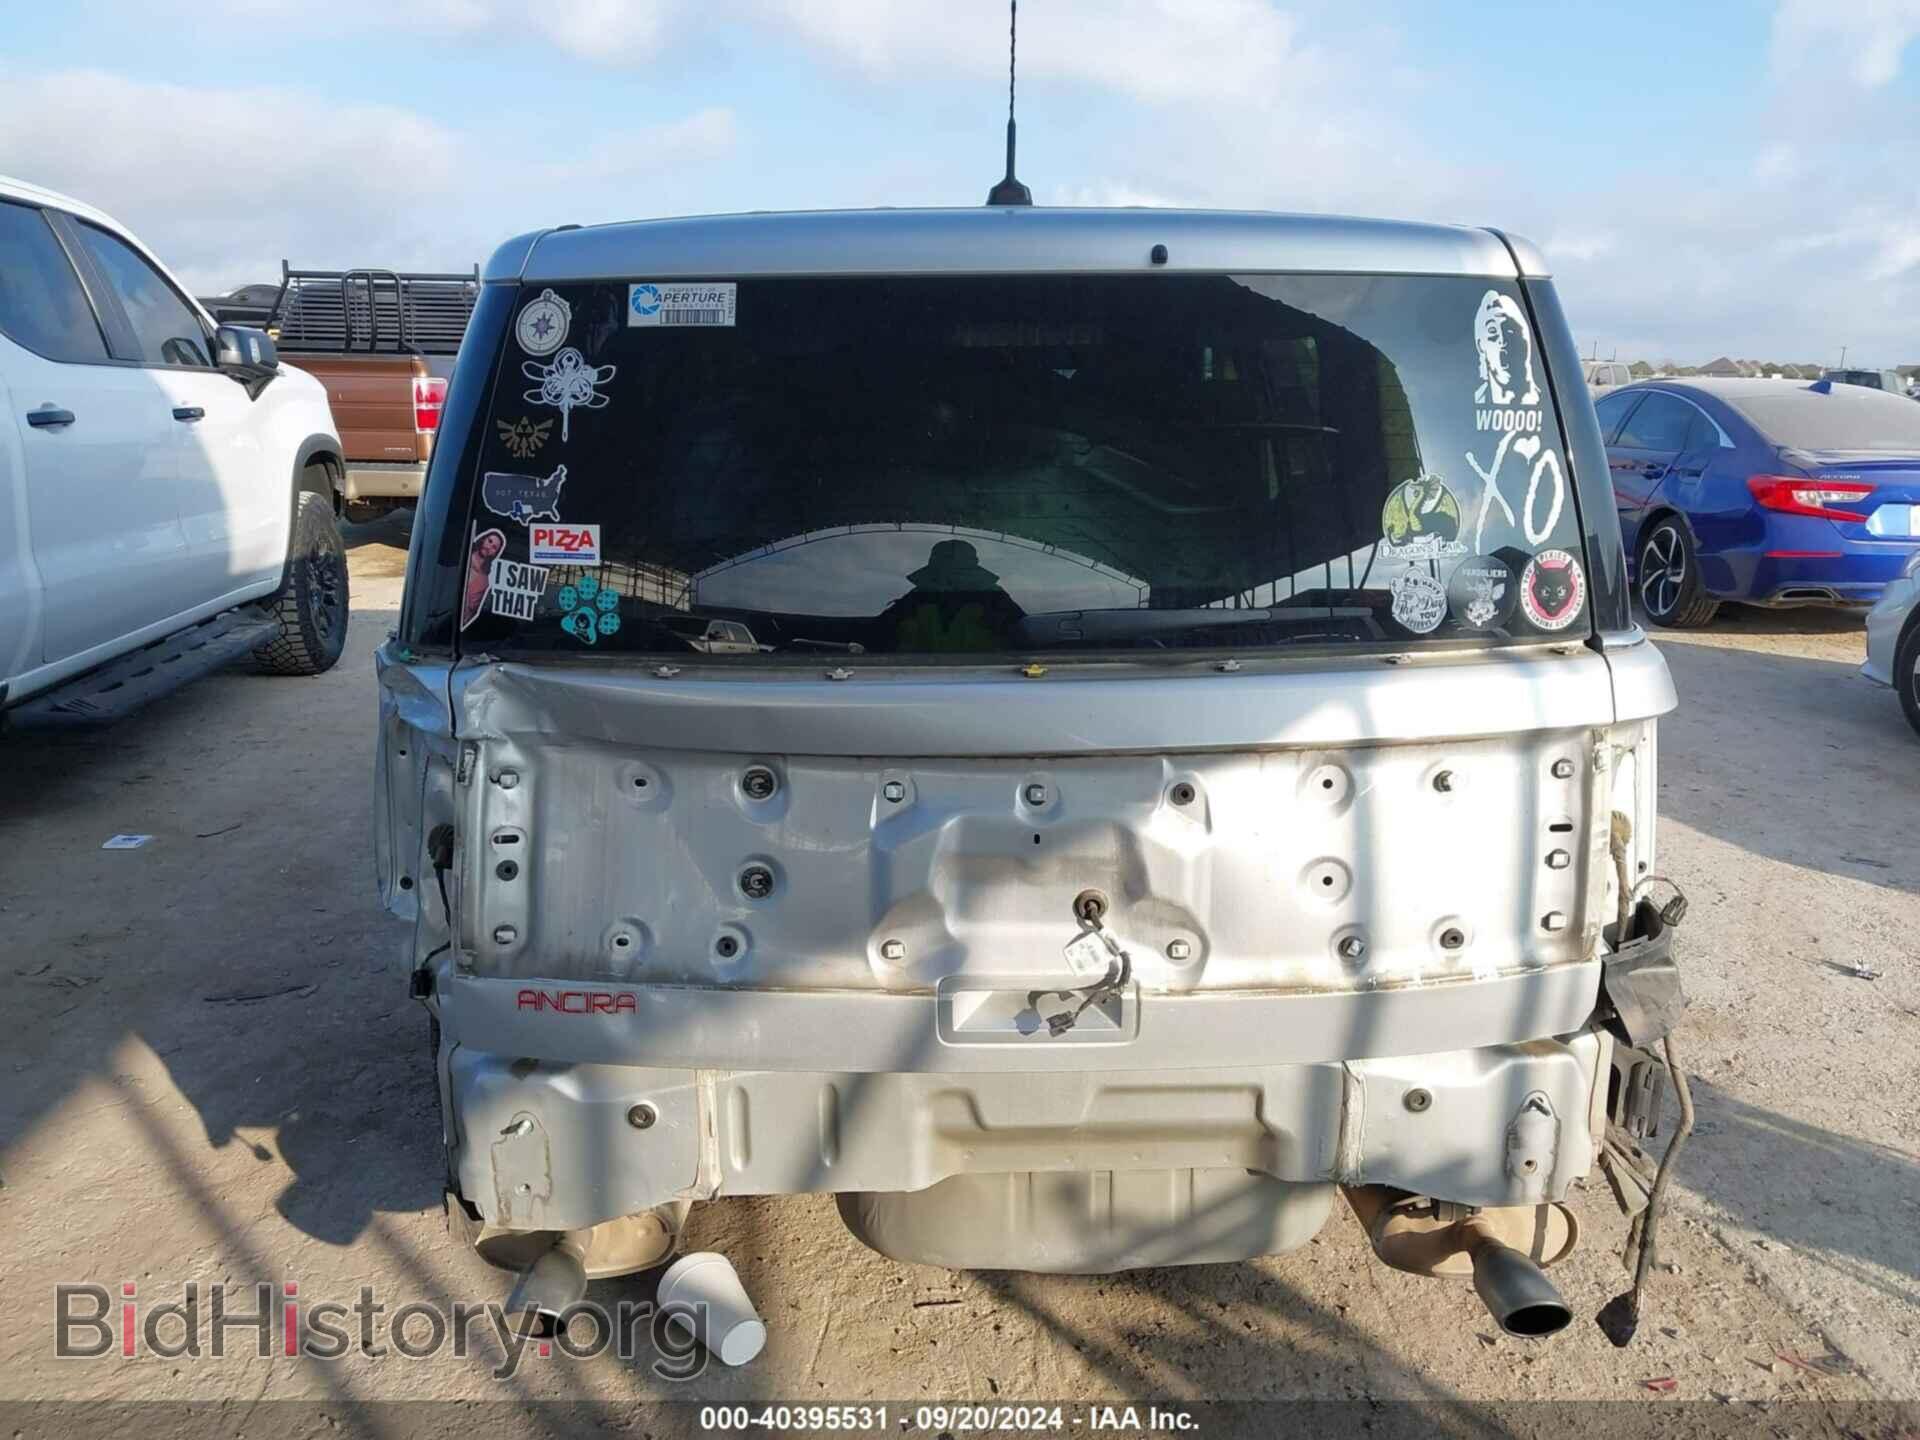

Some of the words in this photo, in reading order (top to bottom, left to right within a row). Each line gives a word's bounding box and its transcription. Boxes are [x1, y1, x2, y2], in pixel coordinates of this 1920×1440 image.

[654, 292, 727, 304] APERTURE
[1475, 409, 1543, 432] WOOOO!
[1465, 430, 1564, 556] XO
[534, 528, 595, 552] PIZZA
[495, 562, 501, 585] I
[506, 564, 548, 594] SAW
[494, 589, 537, 618] THAT
[517, 990, 637, 1015] ANCIRA
